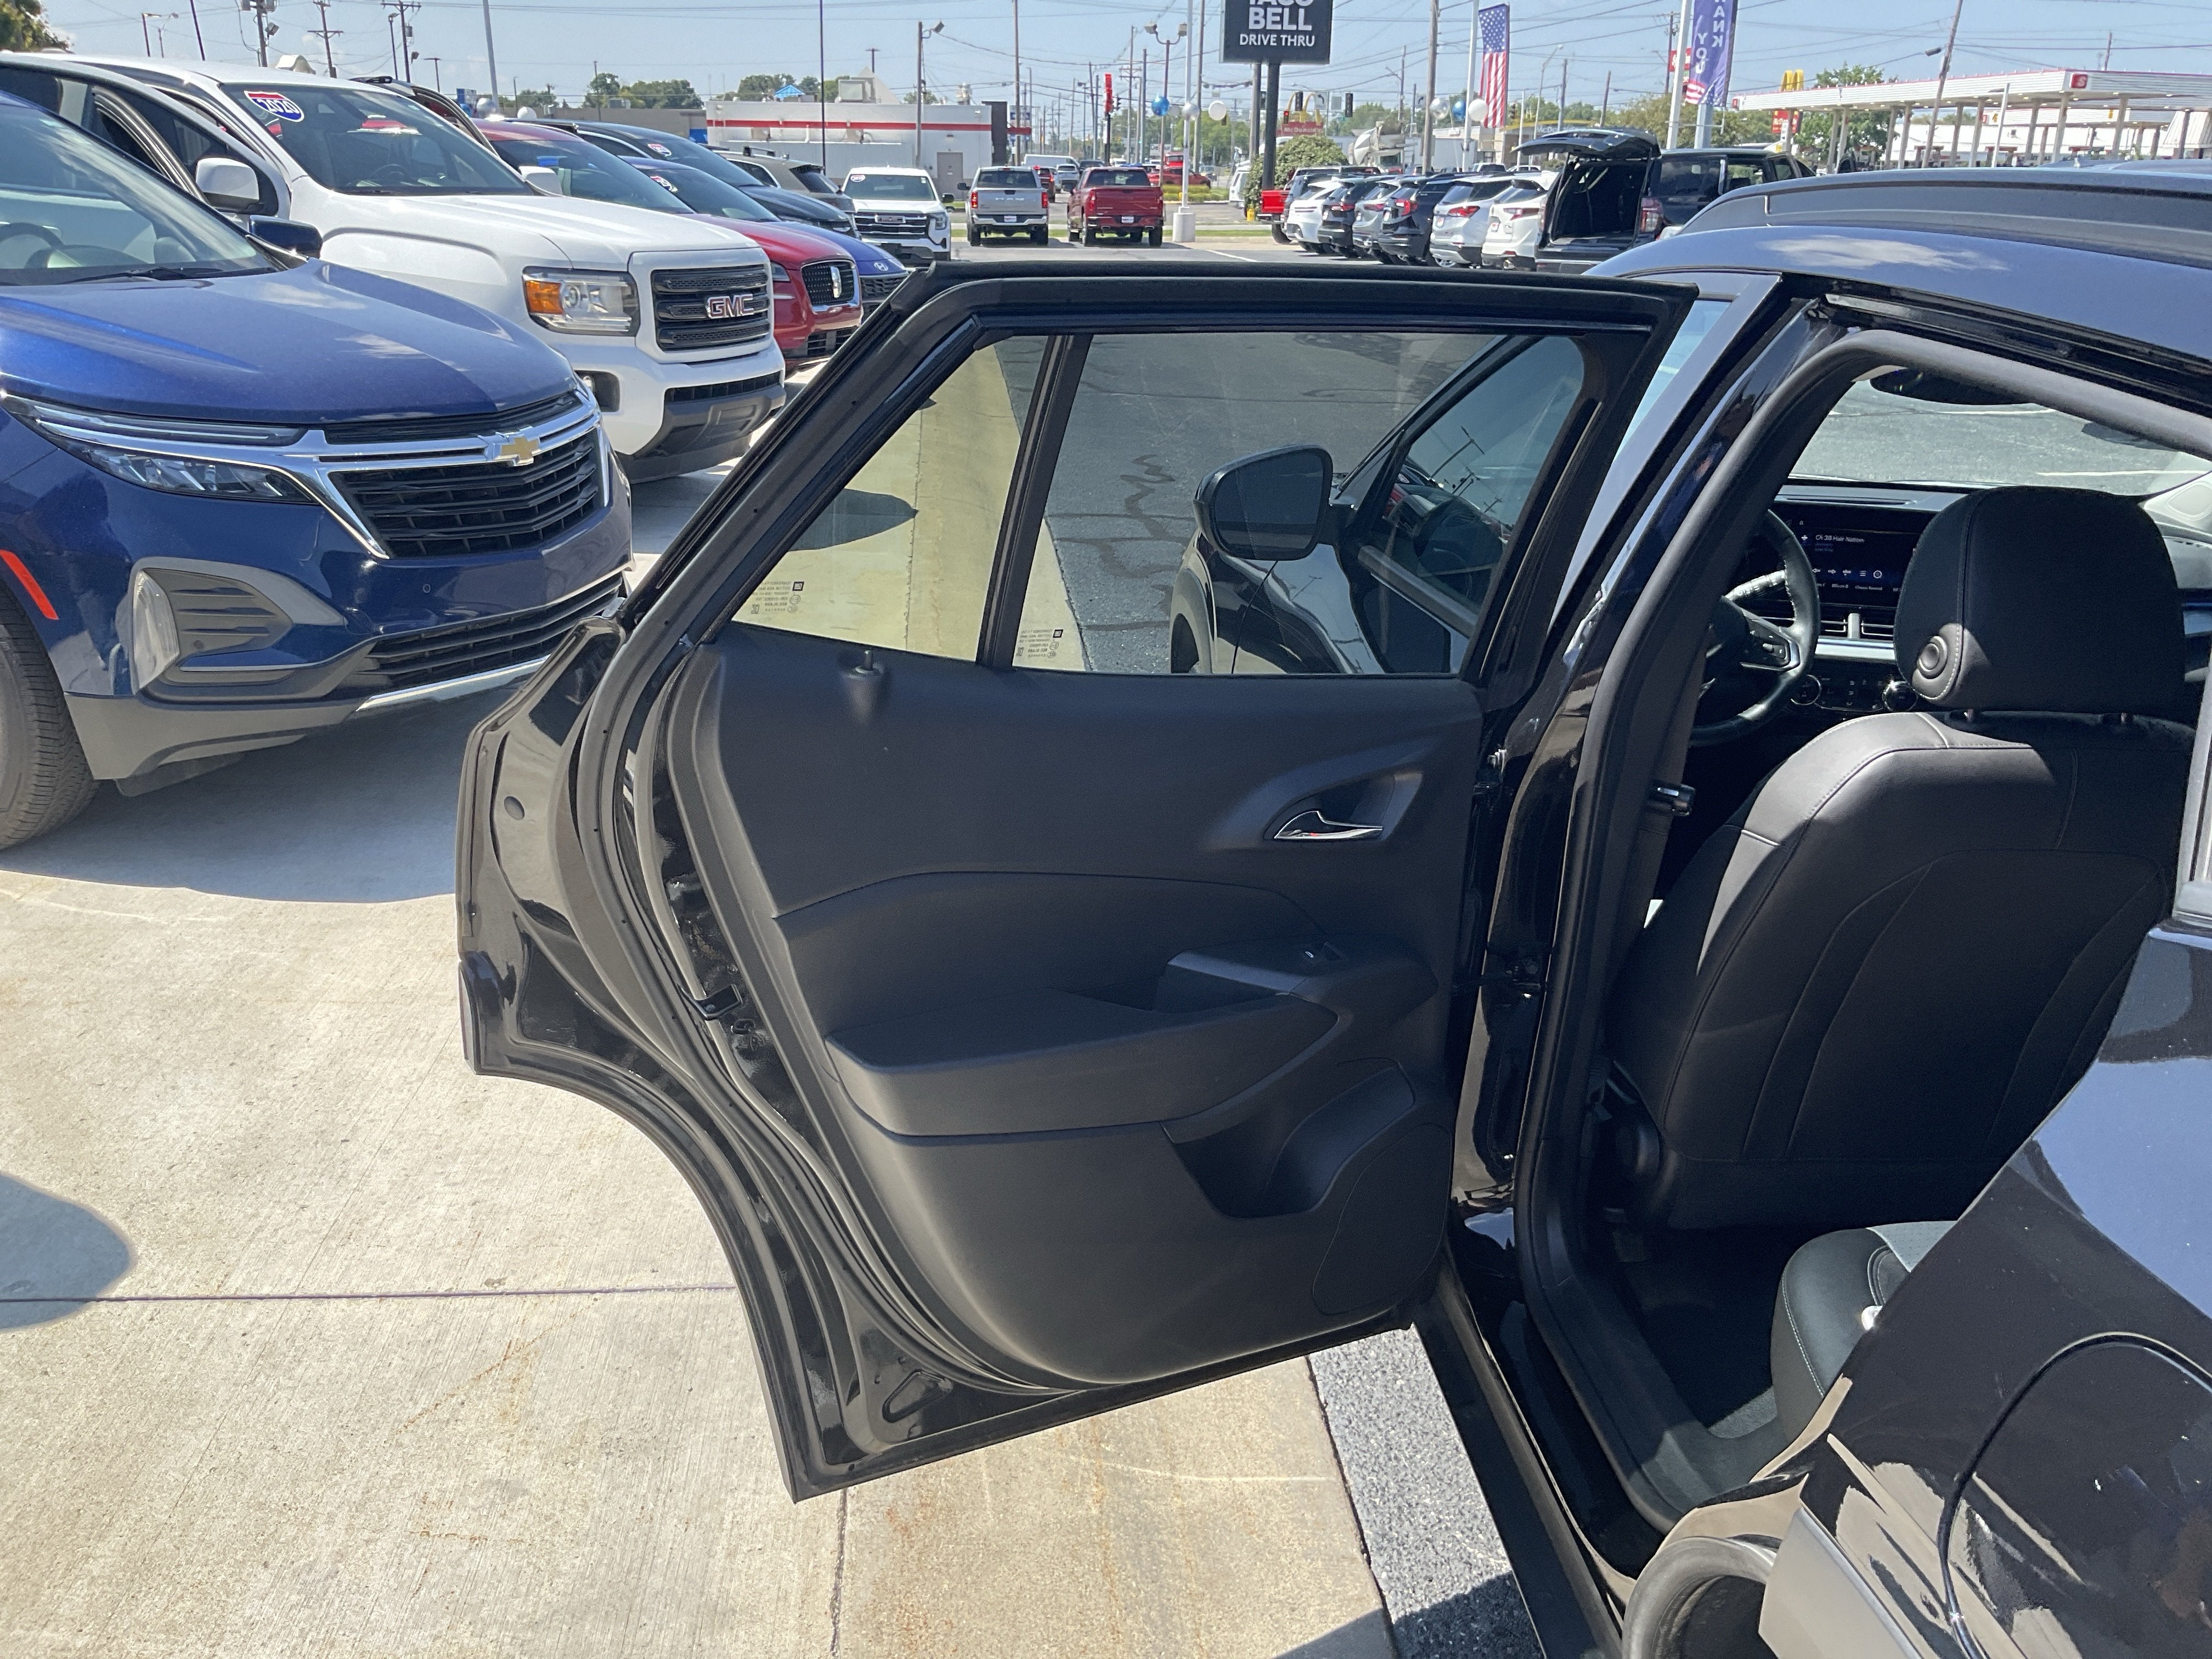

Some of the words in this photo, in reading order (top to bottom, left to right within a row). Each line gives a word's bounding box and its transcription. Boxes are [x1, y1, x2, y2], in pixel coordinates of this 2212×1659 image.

[1249, 7, 1312, 31] BELL
[1239, 33, 1277, 46] DRIVE
[1280, 35, 1315, 47] THRU
[257, 99, 300, 114] 2020
[706, 293, 754, 319] GMC
